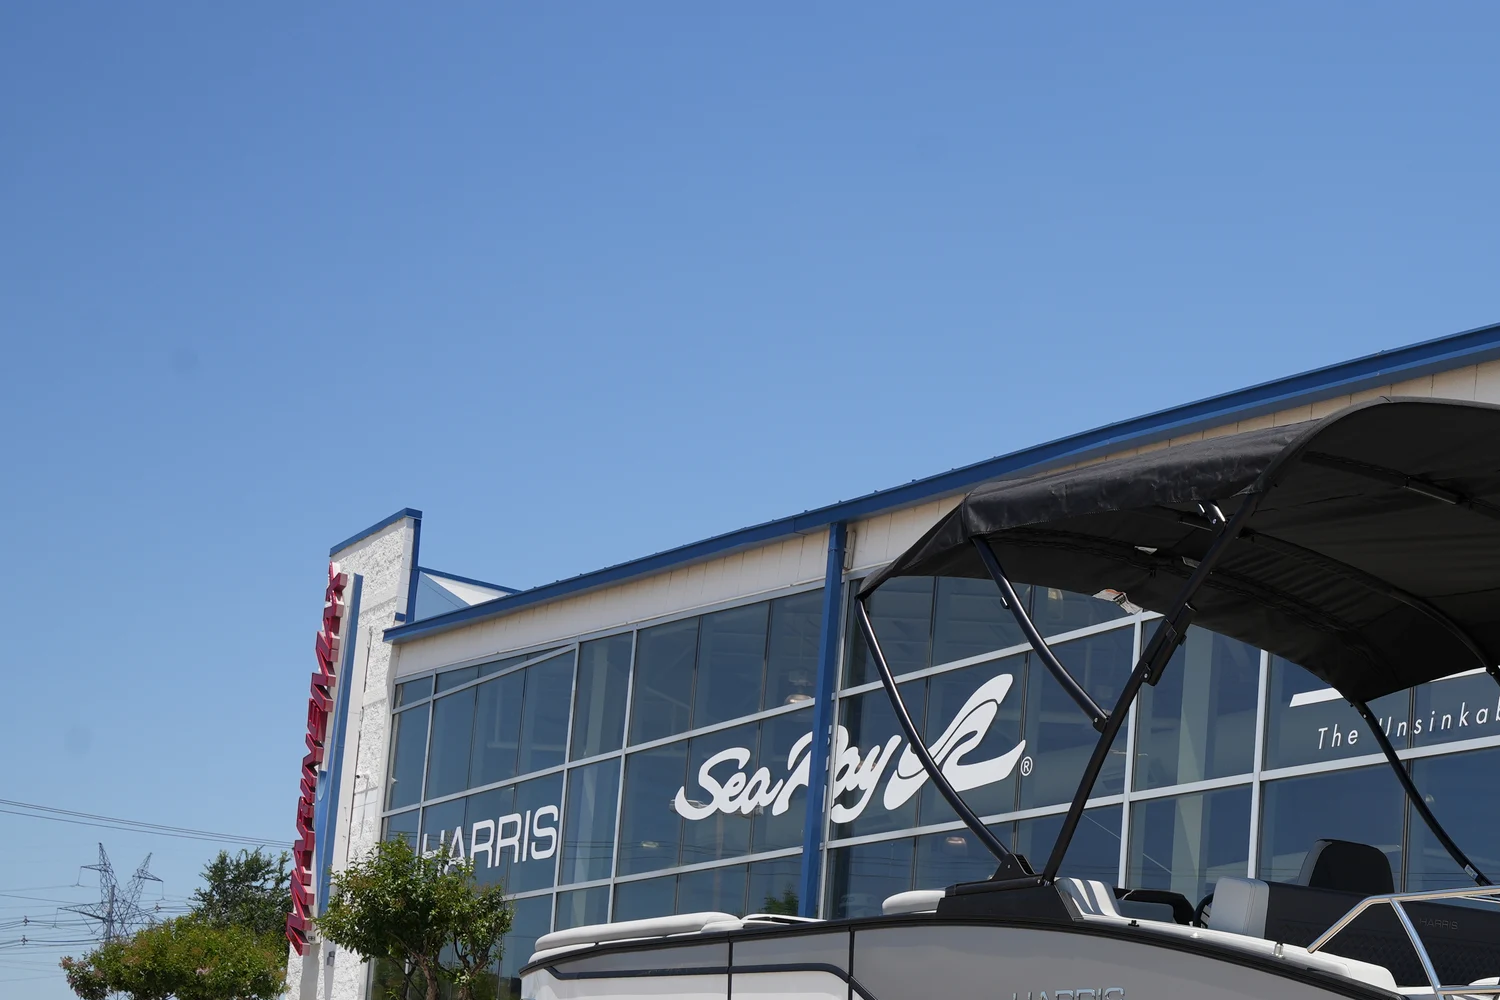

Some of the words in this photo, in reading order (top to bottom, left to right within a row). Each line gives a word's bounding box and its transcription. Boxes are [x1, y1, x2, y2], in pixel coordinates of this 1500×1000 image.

[1317, 723, 1359, 750] The
[420, 805, 559, 878] HARRIS
[1418, 918, 1459, 930] HARRIS
